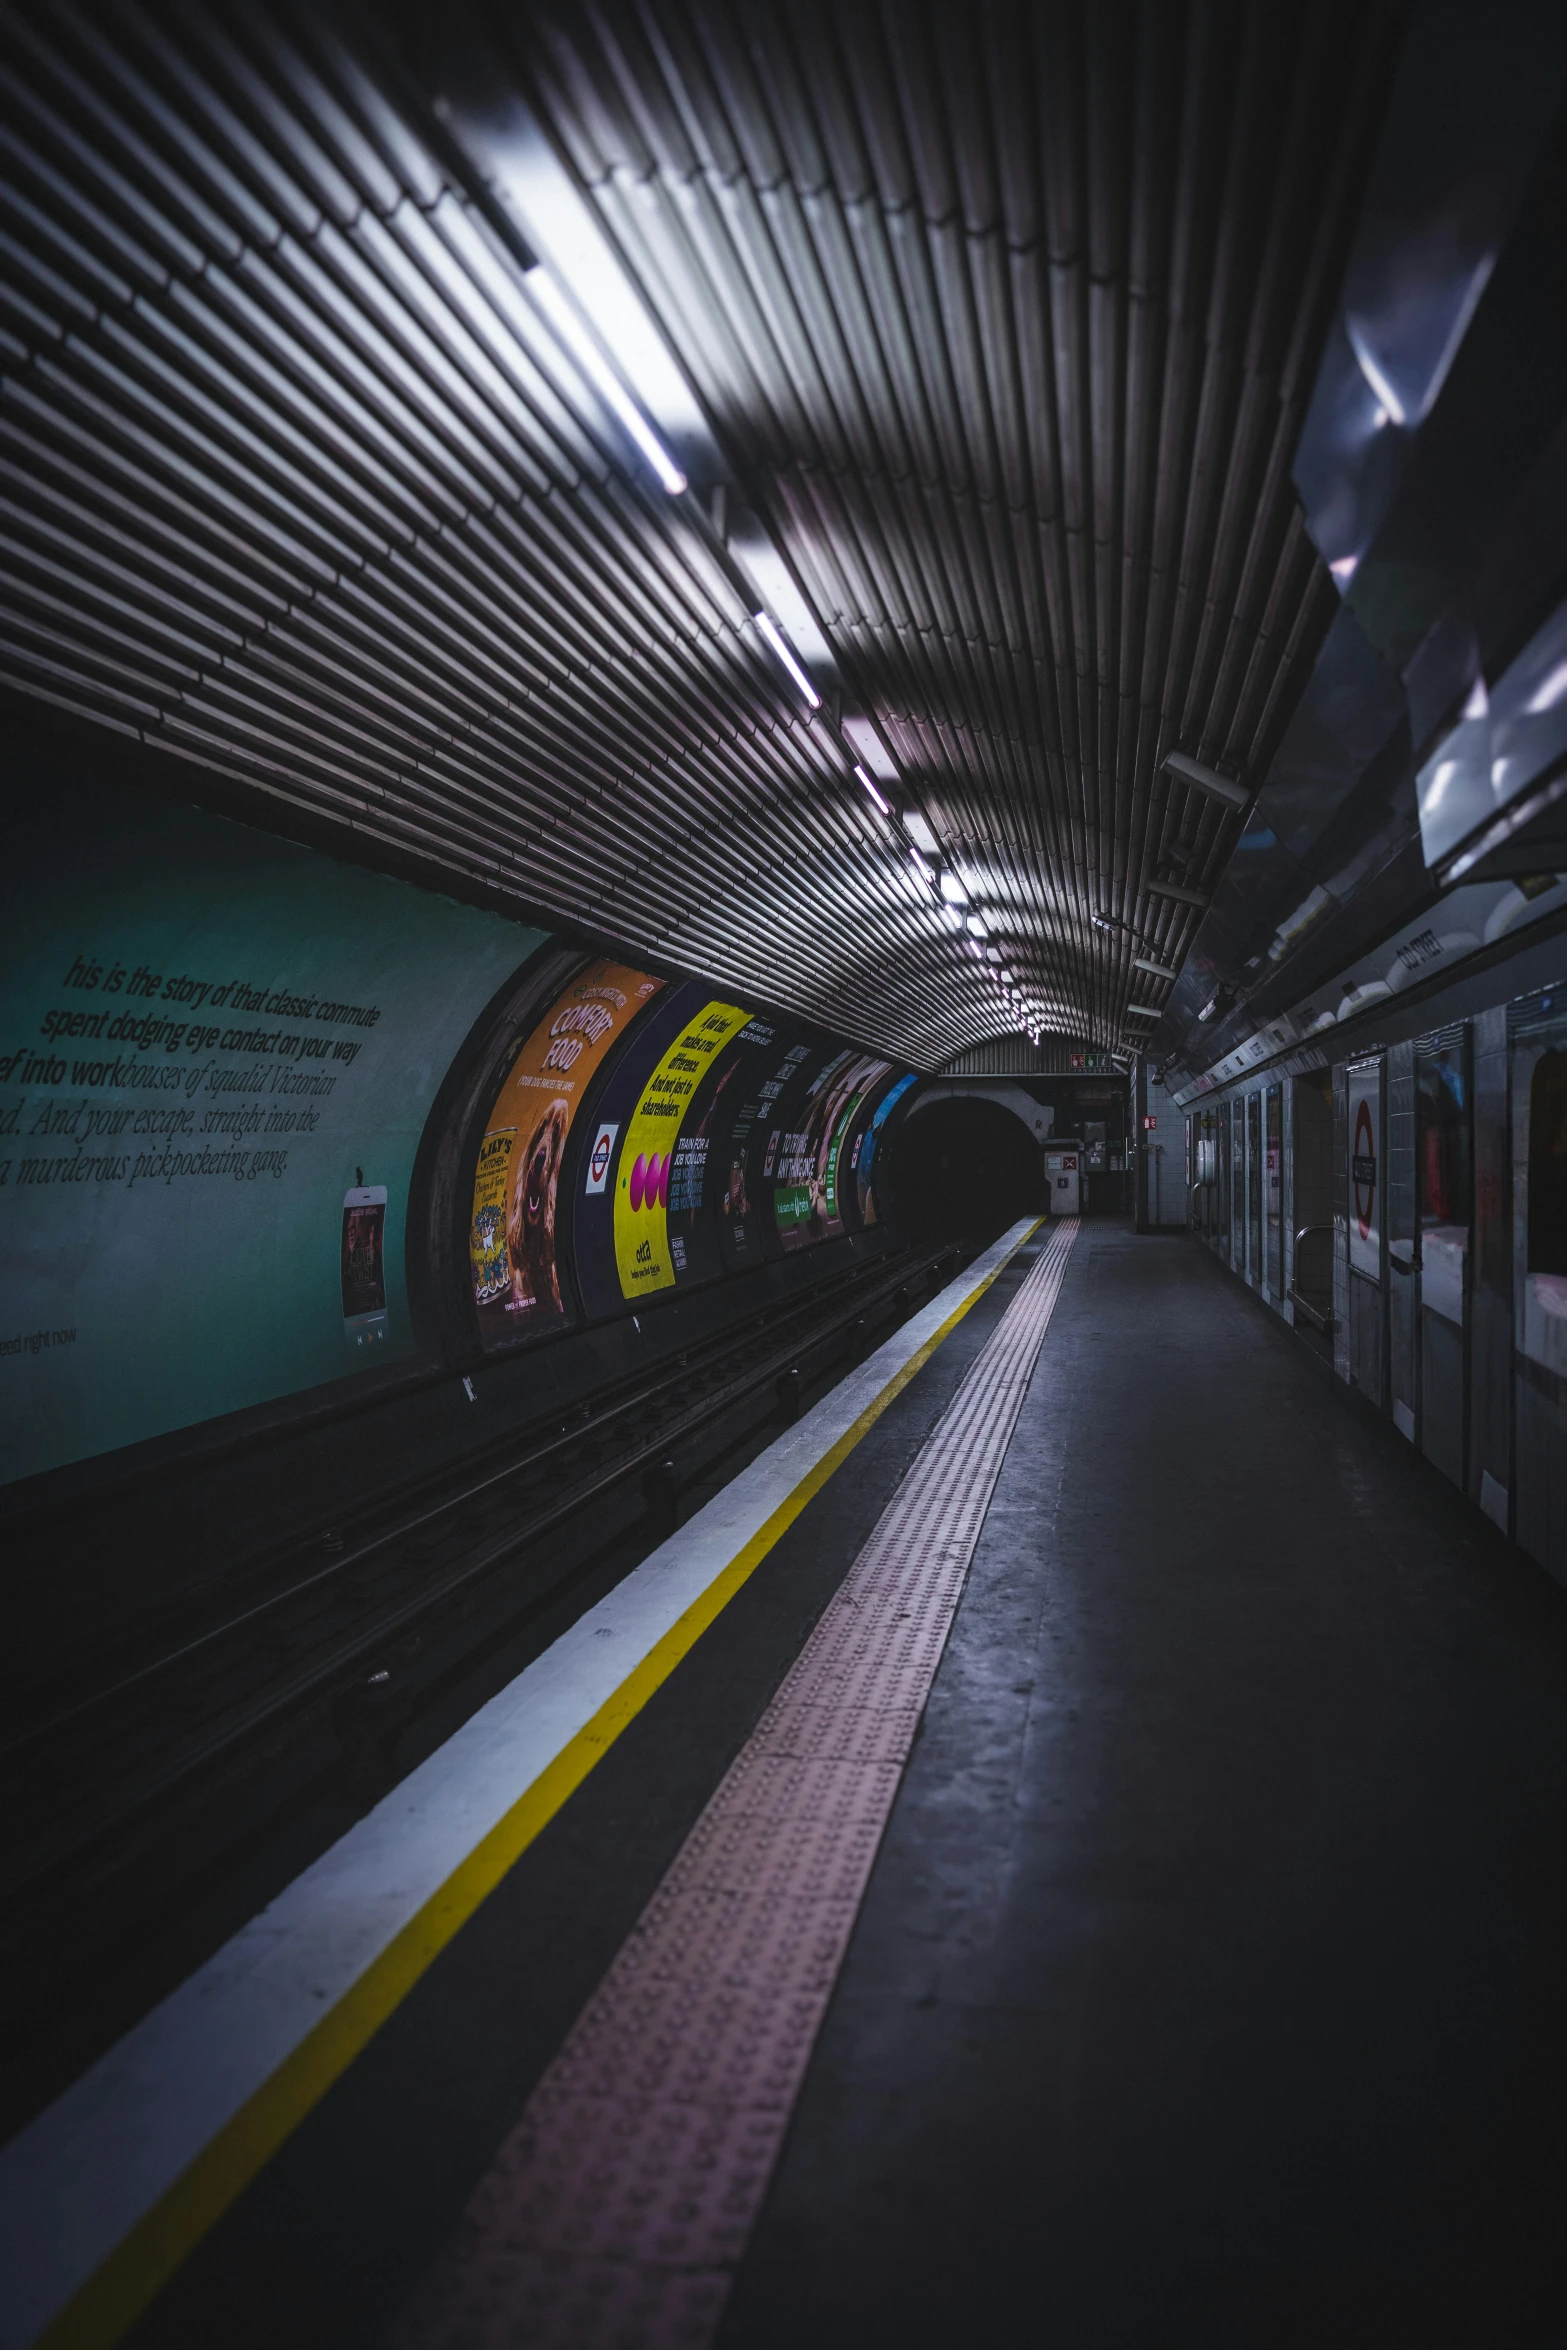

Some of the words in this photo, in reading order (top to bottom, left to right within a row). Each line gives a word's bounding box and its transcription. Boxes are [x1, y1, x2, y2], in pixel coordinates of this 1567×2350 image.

[1396, 945, 1420, 971] OLD
[1409, 928, 1445, 963] STREET
[63, 955, 103, 990] his
[101, 961, 127, 993] is
[126, 965, 163, 997] the
[160, 974, 213, 1011] story
[210, 980, 239, 1008] of
[229, 983, 270, 1012] that
[264, 989, 319, 1019] classic
[315, 1002, 381, 1028] commute
[549, 1003, 614, 1046] COMFORT
[699, 1013, 715, 1028] A
[700, 1014, 723, 1033] job
[713, 1018, 734, 1033] that
[40, 1009, 110, 1043] spent
[107, 1010, 189, 1053] dodging
[186, 1022, 220, 1054] eye
[219, 1027, 282, 1054] contact
[278, 1035, 302, 1056] on
[294, 1036, 333, 1062] your
[331, 1042, 362, 1067] way
[680, 1032, 706, 1049] makes
[701, 1038, 721, 1053] real
[540, 1037, 583, 1072] FOOD
[667, 1052, 700, 1073] difference.
[20, 1051, 67, 1086] into
[71, 1055, 187, 1091] workhouses
[185, 1059, 217, 1099] of
[204, 1063, 274, 1100] squalid
[269, 1065, 338, 1096] Victorian
[649, 1073, 669, 1091] And
[661, 1077, 678, 1093] not
[669, 1076, 689, 1098] just
[683, 1079, 693, 1095] to
[640, 1096, 680, 1117] shareholders.
[28, 1099, 89, 1135] And
[75, 1109, 135, 1144] your
[133, 1107, 196, 1142] escape,
[199, 1103, 267, 1141] straight
[264, 1104, 297, 1134] into
[296, 1105, 321, 1133] the
[480, 1137, 512, 1163] LILY'S
[678, 1137, 695, 1151] TRAIN
[692, 1137, 706, 1151] FOR
[703, 1138, 710, 1150] A
[782, 1134, 792, 1154] TO
[789, 1134, 809, 1154] TRYING
[16, 1147, 131, 1185] murderous
[127, 1144, 251, 1188] pickpocketing
[246, 1150, 288, 1182] gang.
[483, 1155, 504, 1171] KITCHEN
[673, 1153, 685, 1166] JOB
[684, 1153, 696, 1165] YOU
[694, 1152, 708, 1165] LOVE
[777, 1157, 803, 1179] ANYTHING
[799, 1157, 816, 1178] ONCE
[672, 1167, 682, 1181] JOB
[682, 1167, 694, 1180] YOU
[692, 1166, 705, 1179] LOVE
[1360, 1160, 1374, 1181] STREET
[670, 1183, 681, 1197] JOB
[680, 1181, 692, 1196] YOU
[690, 1181, 703, 1195] LOVE
[670, 1197, 680, 1212] JOB
[679, 1196, 690, 1210] YOU
[689, 1194, 703, 1209] LOVE
[636, 1239, 652, 1264] otta
[24, 1329, 50, 1356] right
[52, 1328, 77, 1347] now
